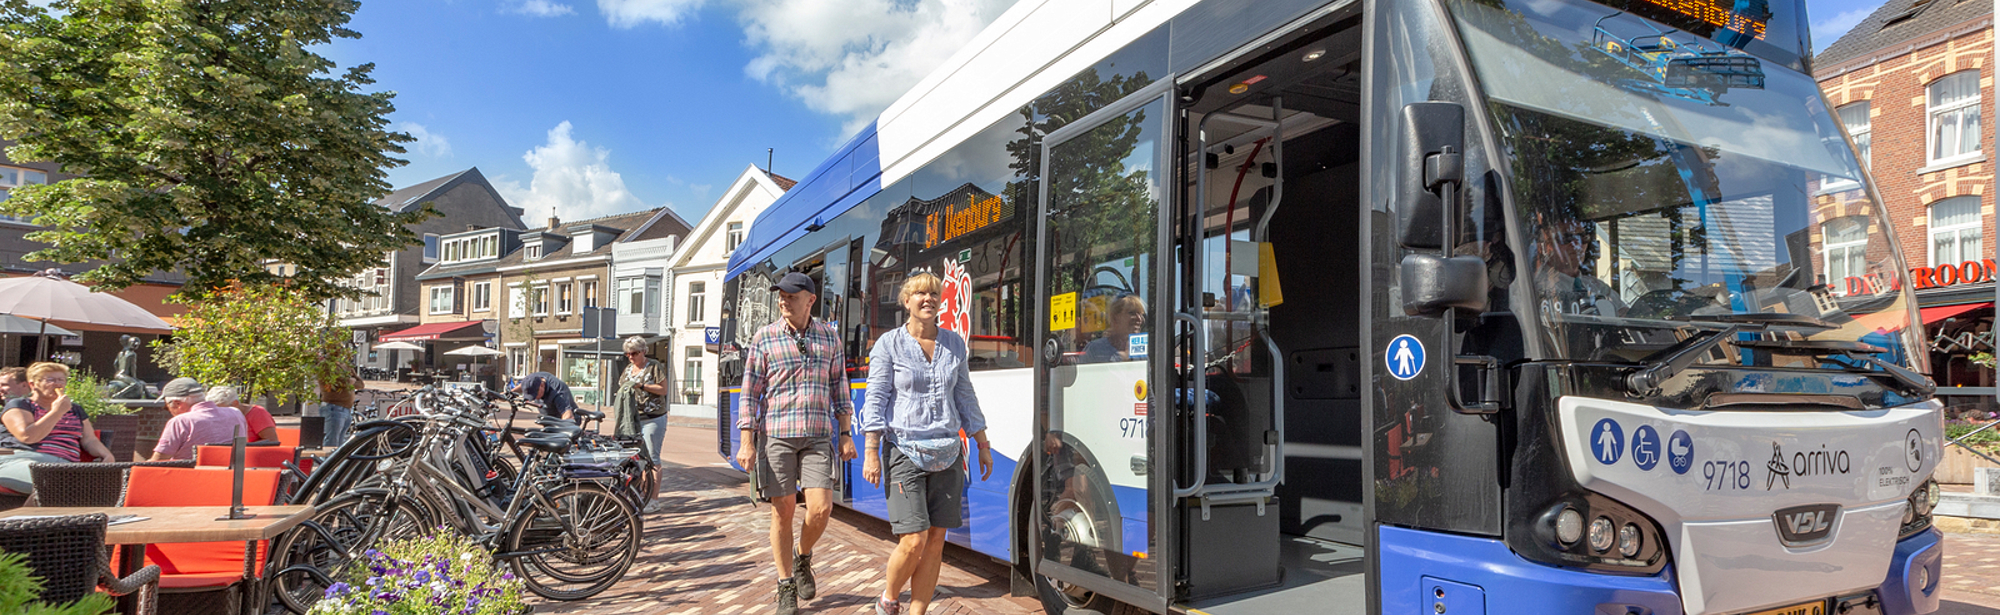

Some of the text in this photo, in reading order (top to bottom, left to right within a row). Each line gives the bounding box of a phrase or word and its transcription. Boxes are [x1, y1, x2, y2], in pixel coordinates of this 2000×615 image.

[925, 211, 938, 248] 54
[1703, 443, 1850, 491] 9718 arriva
[1785, 511, 1829, 534] VDL
